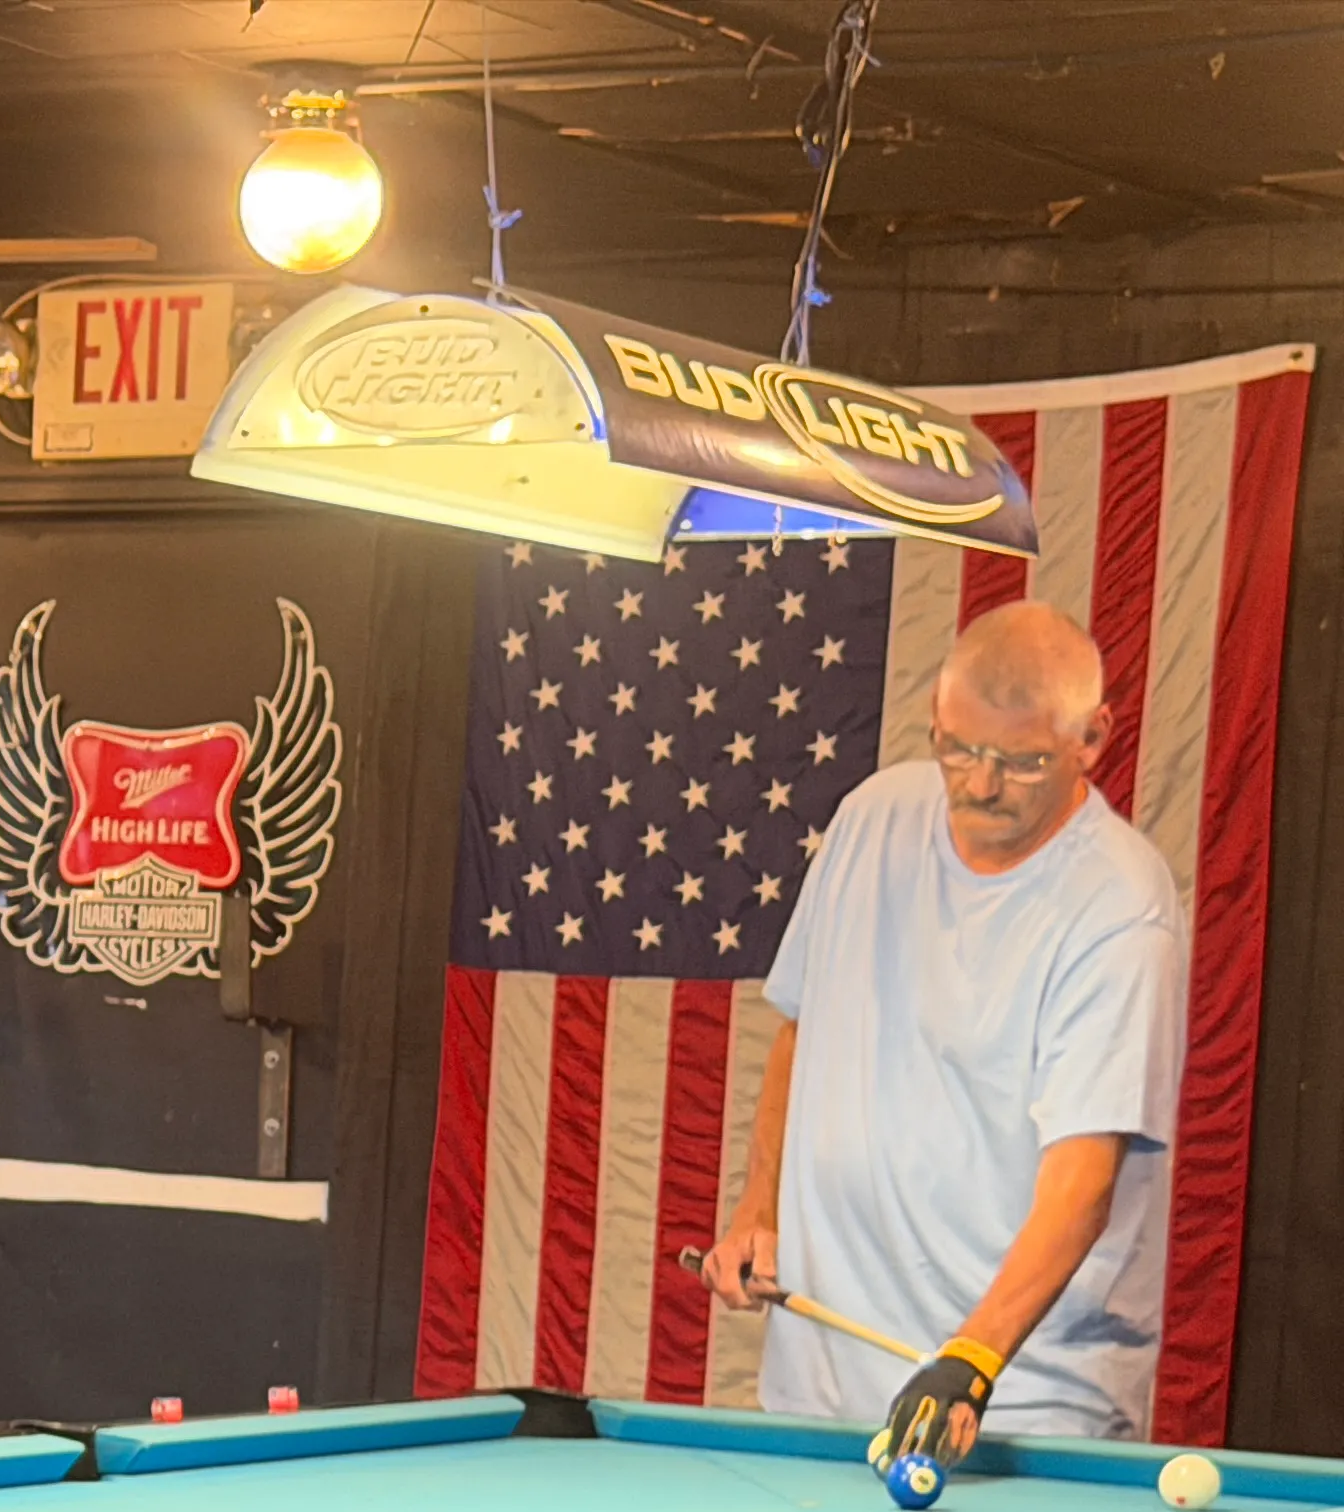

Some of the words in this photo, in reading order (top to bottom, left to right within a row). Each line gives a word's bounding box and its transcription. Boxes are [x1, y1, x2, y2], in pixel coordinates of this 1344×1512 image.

[73, 296, 203, 404] EXIT
[603, 333, 767, 421] BUD
[786, 382, 975, 478] LIGHT
[113, 763, 193, 810] Miller
[91, 816, 153, 844] HIGH
[157, 817, 213, 845] LIFE
[112, 869, 183, 897] MOTOR
[80, 903, 208, 932] HARLEY-DAVIDSON
